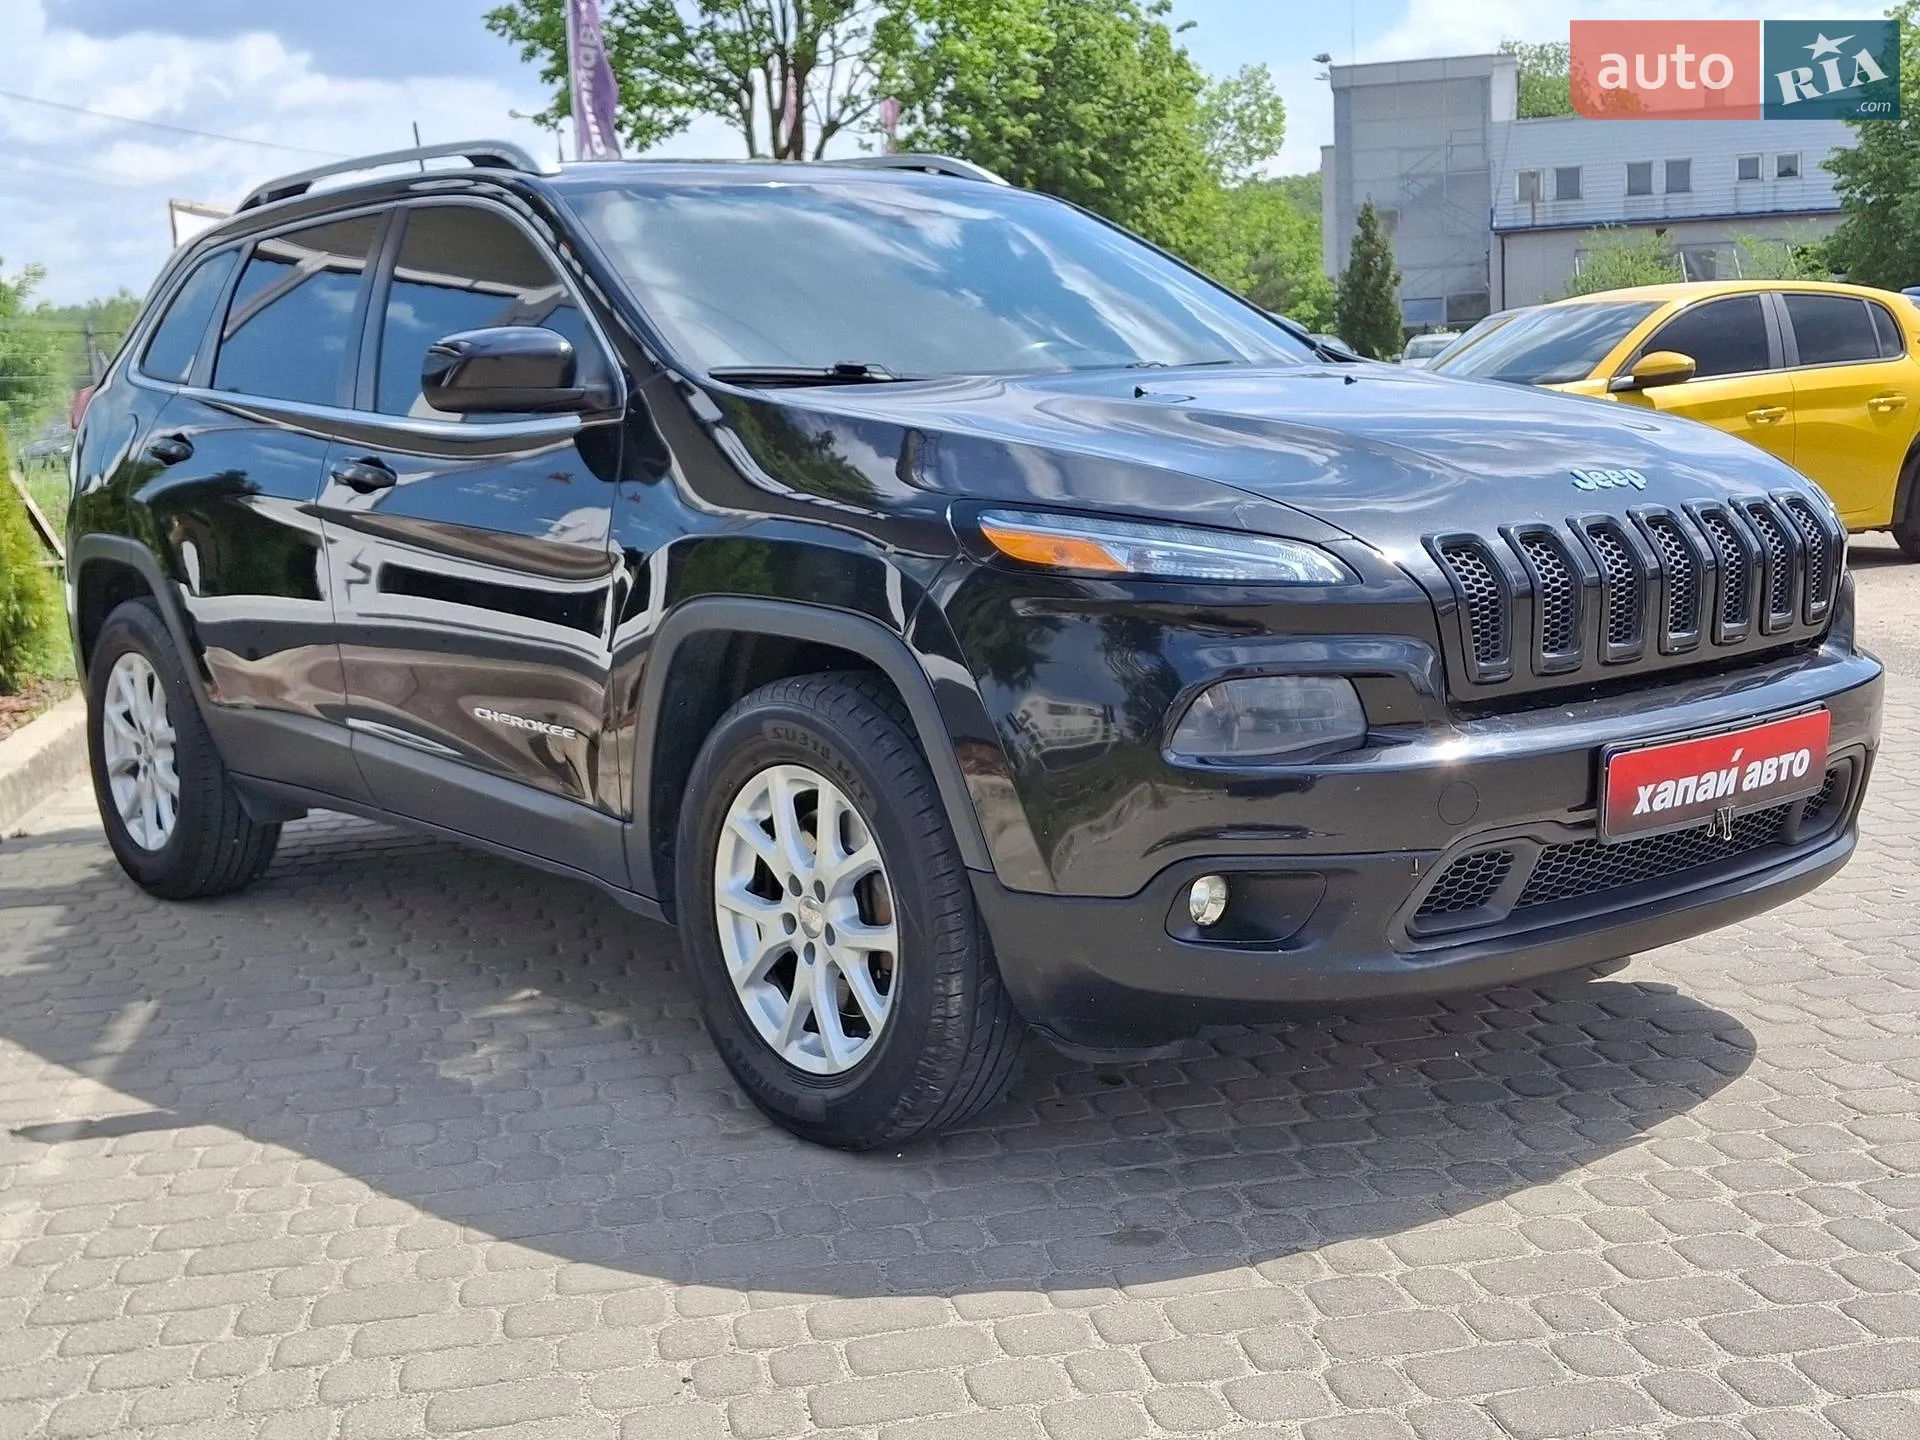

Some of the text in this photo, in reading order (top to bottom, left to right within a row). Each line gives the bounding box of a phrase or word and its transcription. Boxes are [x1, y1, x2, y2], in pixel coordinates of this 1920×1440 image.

[1569, 468, 1647, 491] Jeep
[473, 707, 578, 740] CHEROKEE
[1742, 748, 1810, 791] авто
